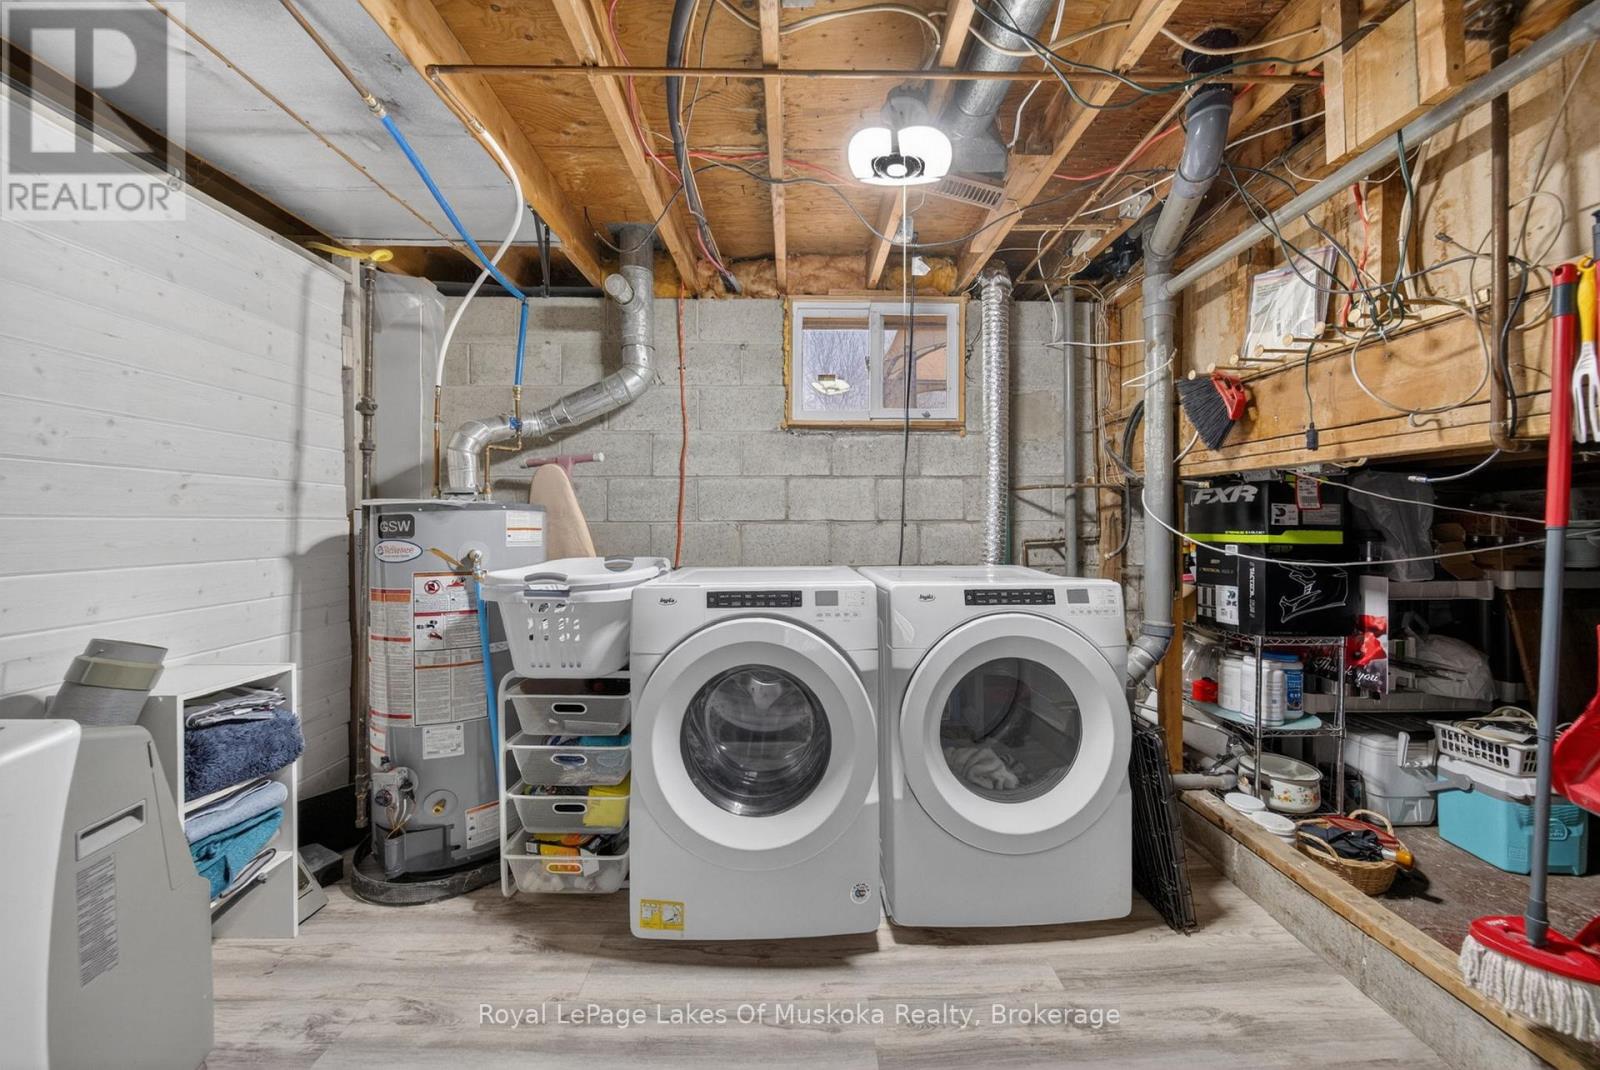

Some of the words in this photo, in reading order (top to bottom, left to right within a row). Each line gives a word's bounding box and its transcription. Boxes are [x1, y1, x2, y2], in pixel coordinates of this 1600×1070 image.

[1193, 485, 1258, 505] FXR
[379, 520, 411, 532] GSW
[1312, 656, 1353, 676] Thak
[1357, 670, 1379, 687] you
